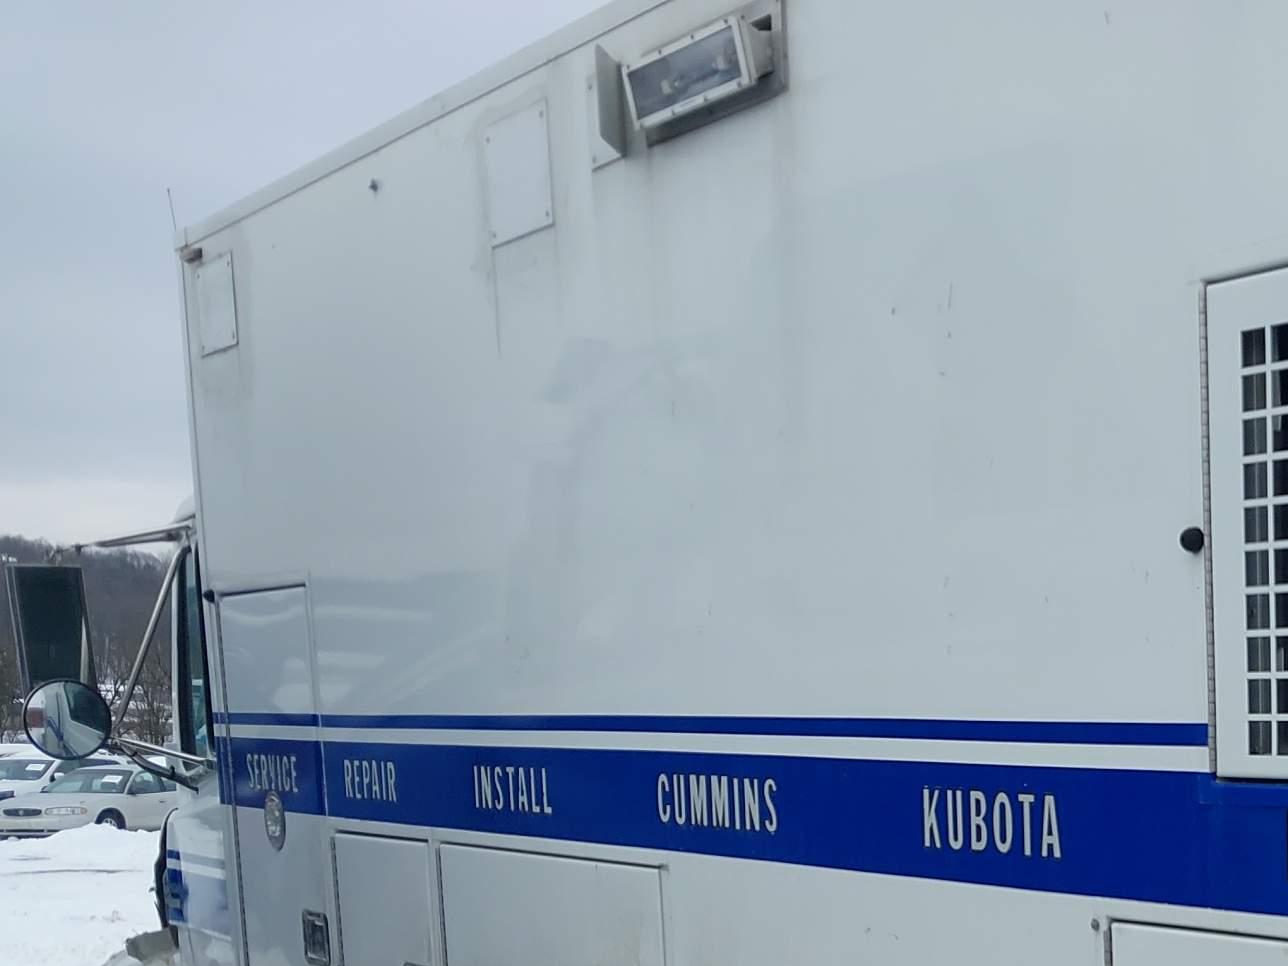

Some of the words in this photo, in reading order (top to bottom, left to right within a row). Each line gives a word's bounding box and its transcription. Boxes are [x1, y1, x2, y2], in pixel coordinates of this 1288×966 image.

[246, 753, 299, 793] SERVICE
[343, 759, 398, 803] REPAIR
[473, 765, 553, 815] INSTALL
[656, 773, 778, 834] CUMMINS
[923, 787, 1062, 859] KUBOTA
